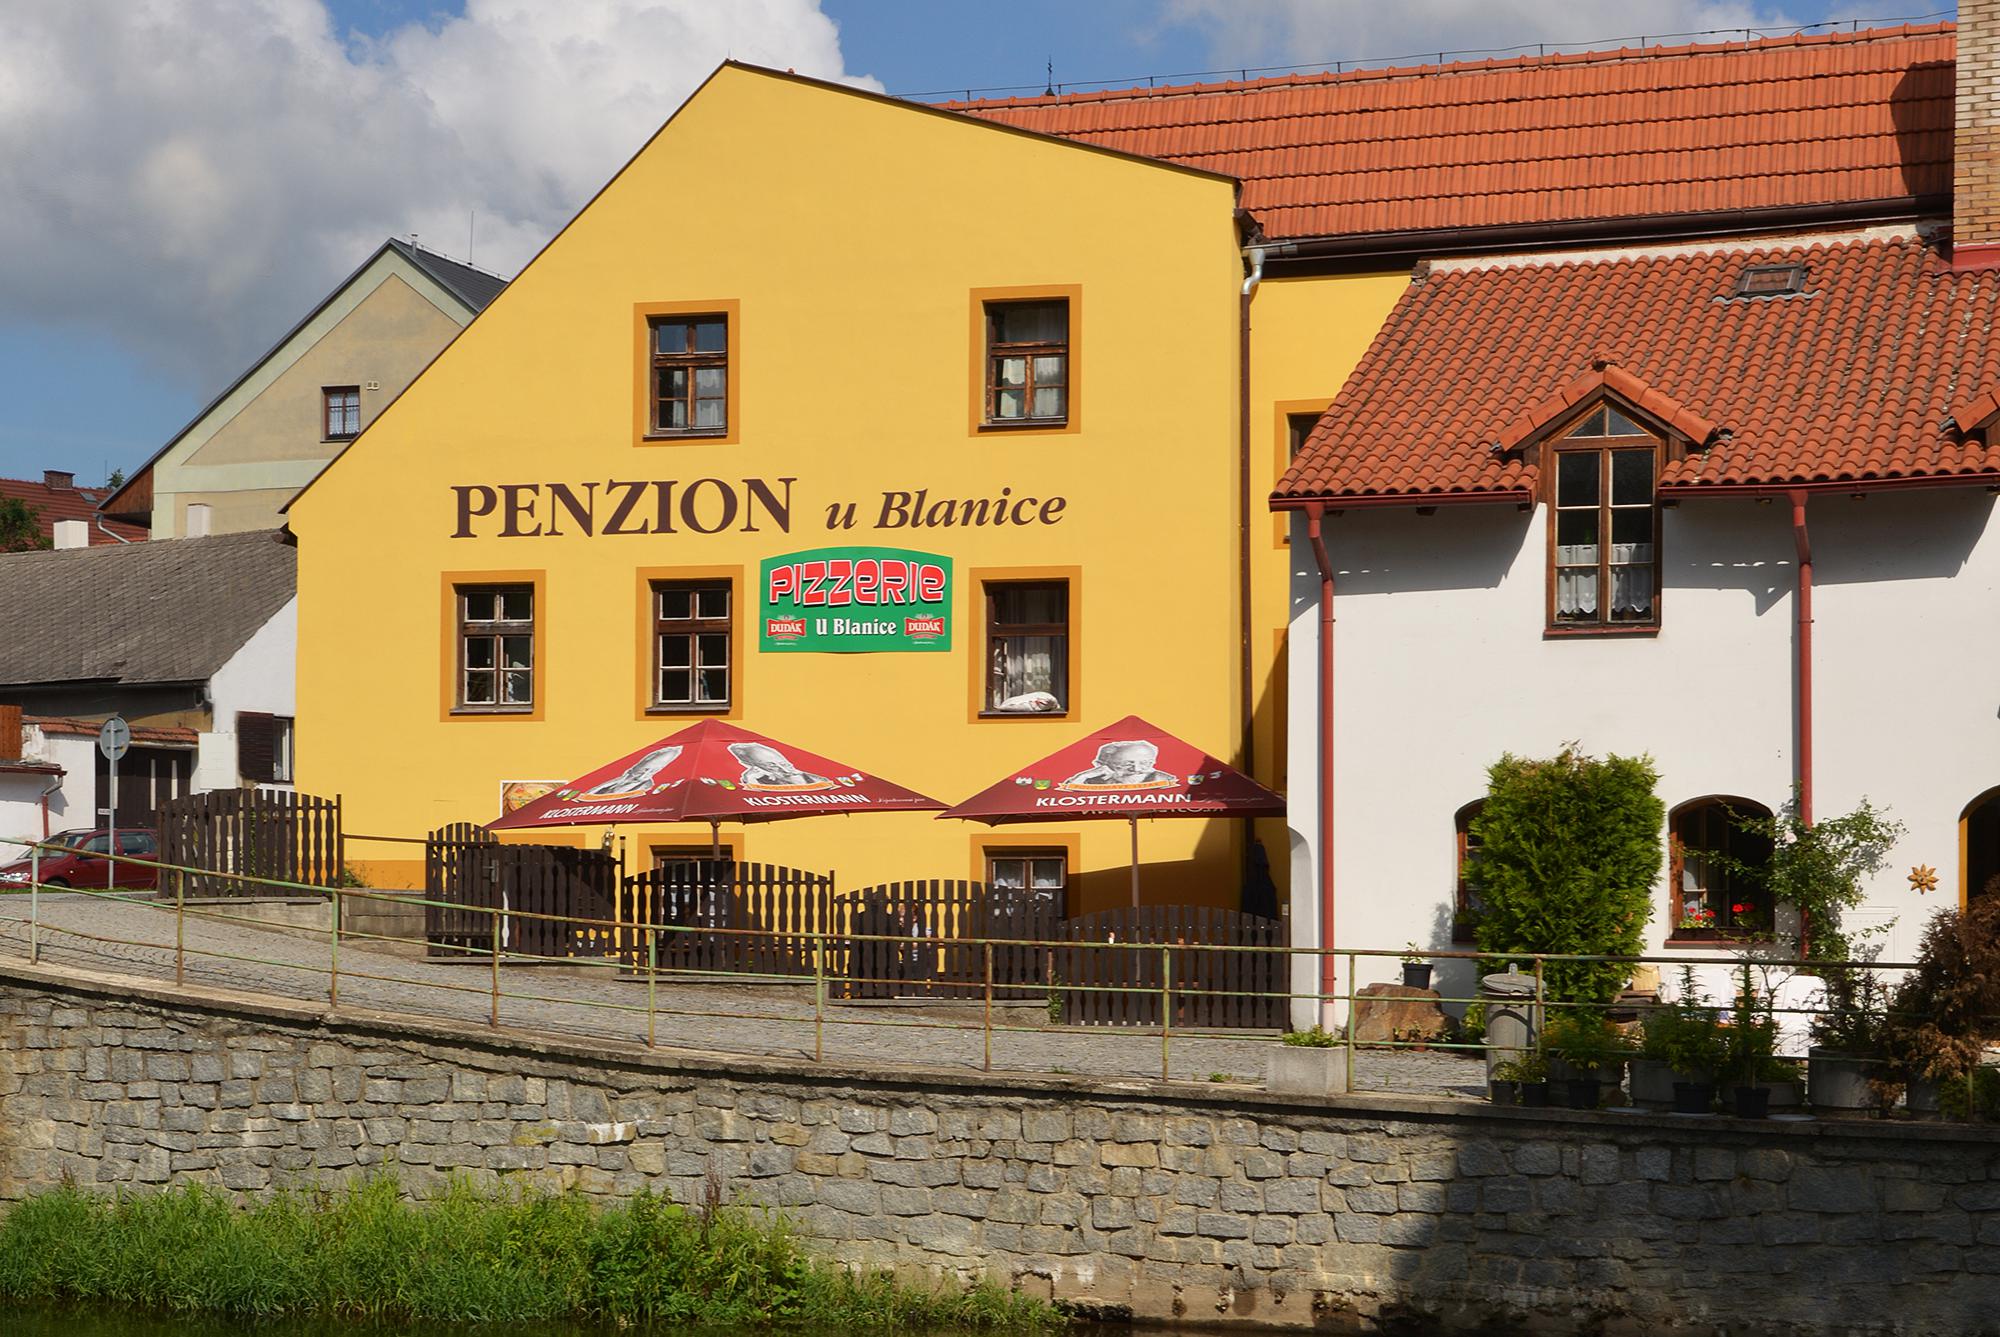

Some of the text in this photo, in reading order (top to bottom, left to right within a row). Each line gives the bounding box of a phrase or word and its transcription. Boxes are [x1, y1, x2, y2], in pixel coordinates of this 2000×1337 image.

[450, 478, 1068, 540] PENZION u Blanice
[833, 617, 897, 636] Blanice
[743, 793, 871, 807] KLOSTERMANN
[1036, 793, 1191, 807] KLOSTERMANN
[539, 803, 640, 820] KLOSTERMANN
